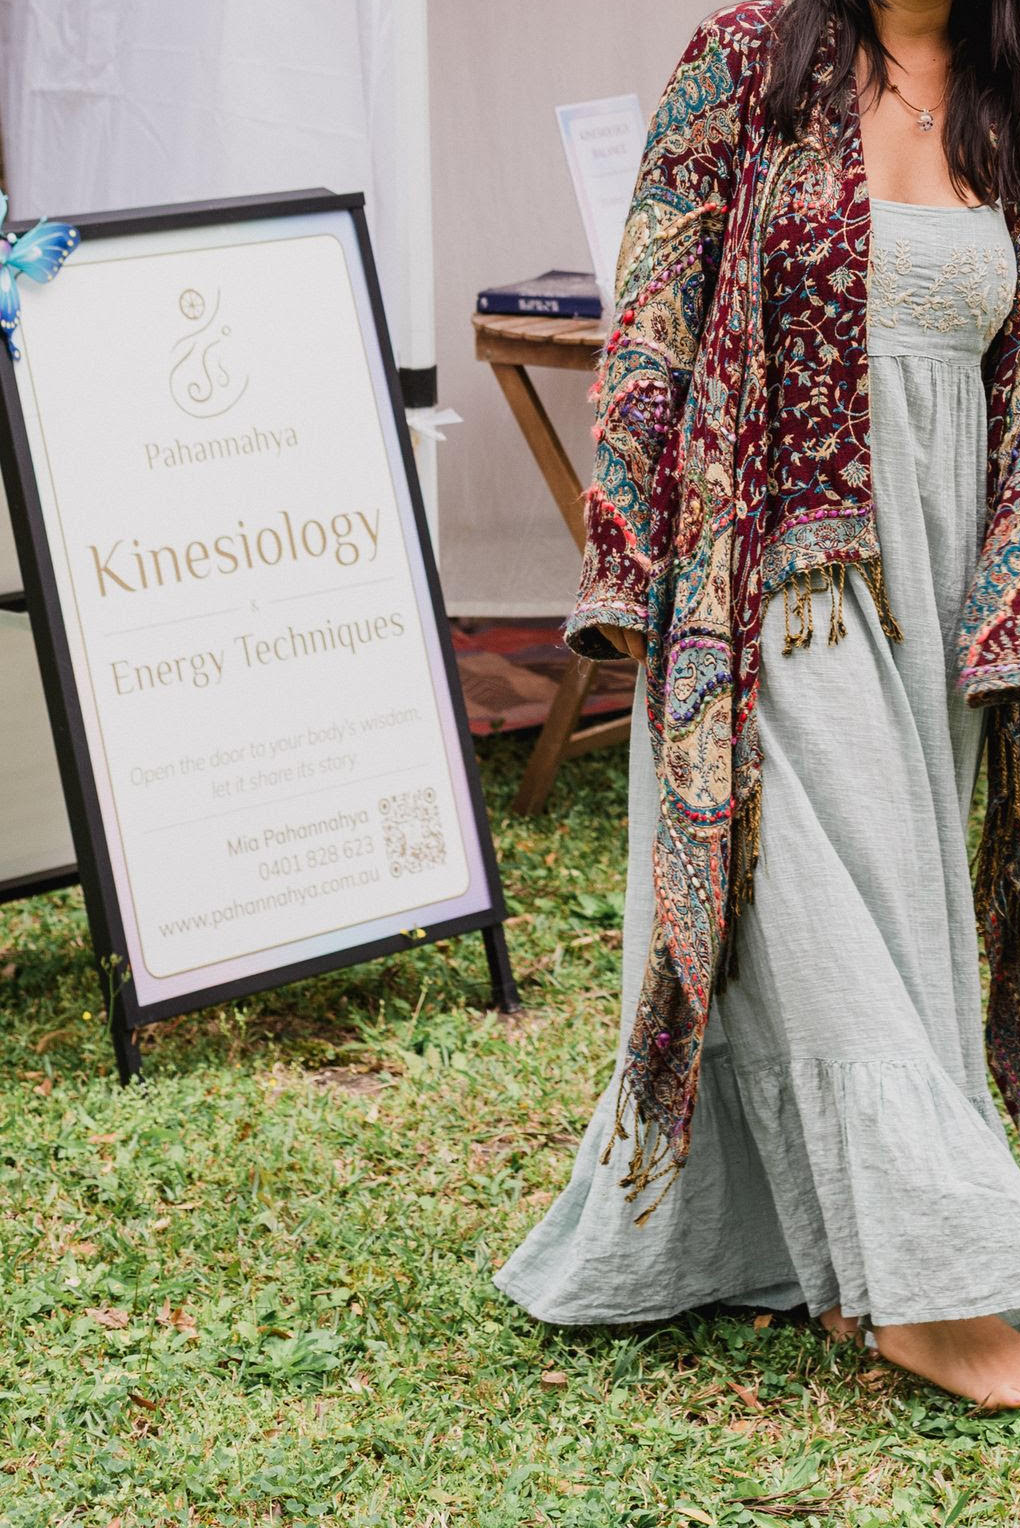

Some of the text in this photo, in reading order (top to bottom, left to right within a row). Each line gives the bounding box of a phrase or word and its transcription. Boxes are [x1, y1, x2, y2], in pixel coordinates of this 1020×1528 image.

[144, 424, 299, 471] Pahannahya
[86, 507, 382, 598] Kinesiology
[109, 611, 406, 696] Energy Techniques
[129, 762, 175, 789] Open
[180, 757, 206, 775] the
[209, 747, 246, 769] door
[250, 743, 267, 760] to
[268, 734, 303, 760] your
[211, 781, 231, 800] let
[235, 775, 246, 793] it
[249, 766, 294, 791] share
[296, 760, 315, 780] its
[226, 810, 370, 858] Mia Pahannahya
[258, 836, 375, 881] 0401 828 623
[158, 867, 381, 939] www.pahannahya.com.au
